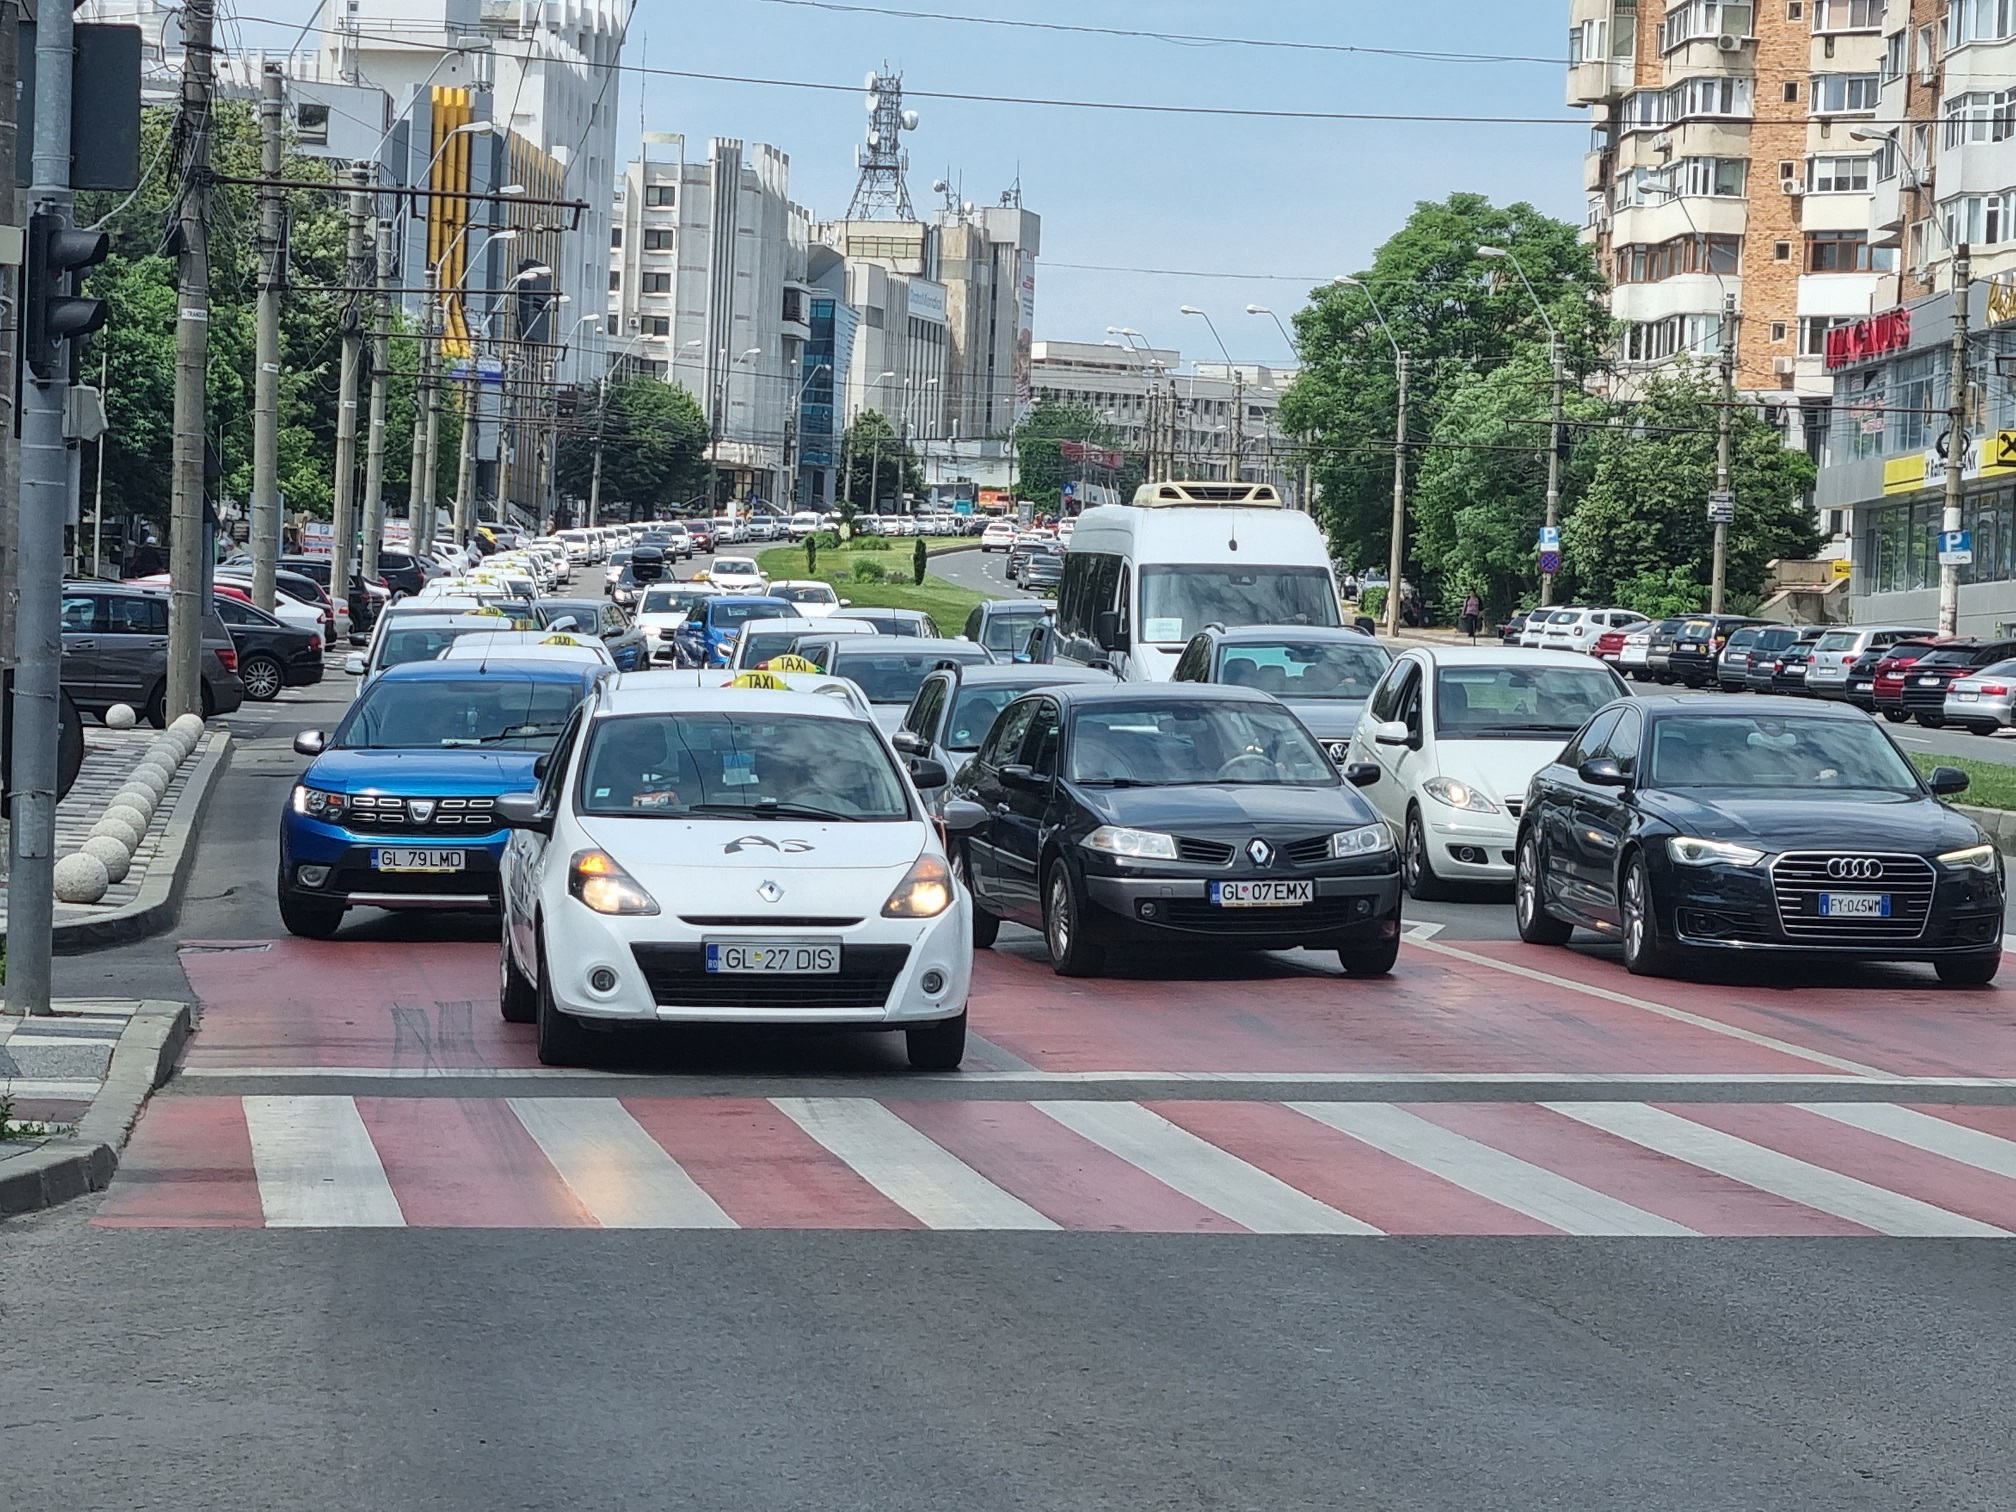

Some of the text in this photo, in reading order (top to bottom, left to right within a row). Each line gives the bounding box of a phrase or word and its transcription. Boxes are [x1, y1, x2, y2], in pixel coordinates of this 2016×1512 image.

[1545, 527, 1556, 543] P
[1946, 532, 1962, 552] P
[554, 635, 570, 646] TAXI
[780, 657, 807, 672] TAXI
[746, 674, 774, 690] TAXI
[382, 851, 401, 867] GL
[1223, 884, 1245, 900] GL
[726, 948, 832, 969] GL 27 DIS
